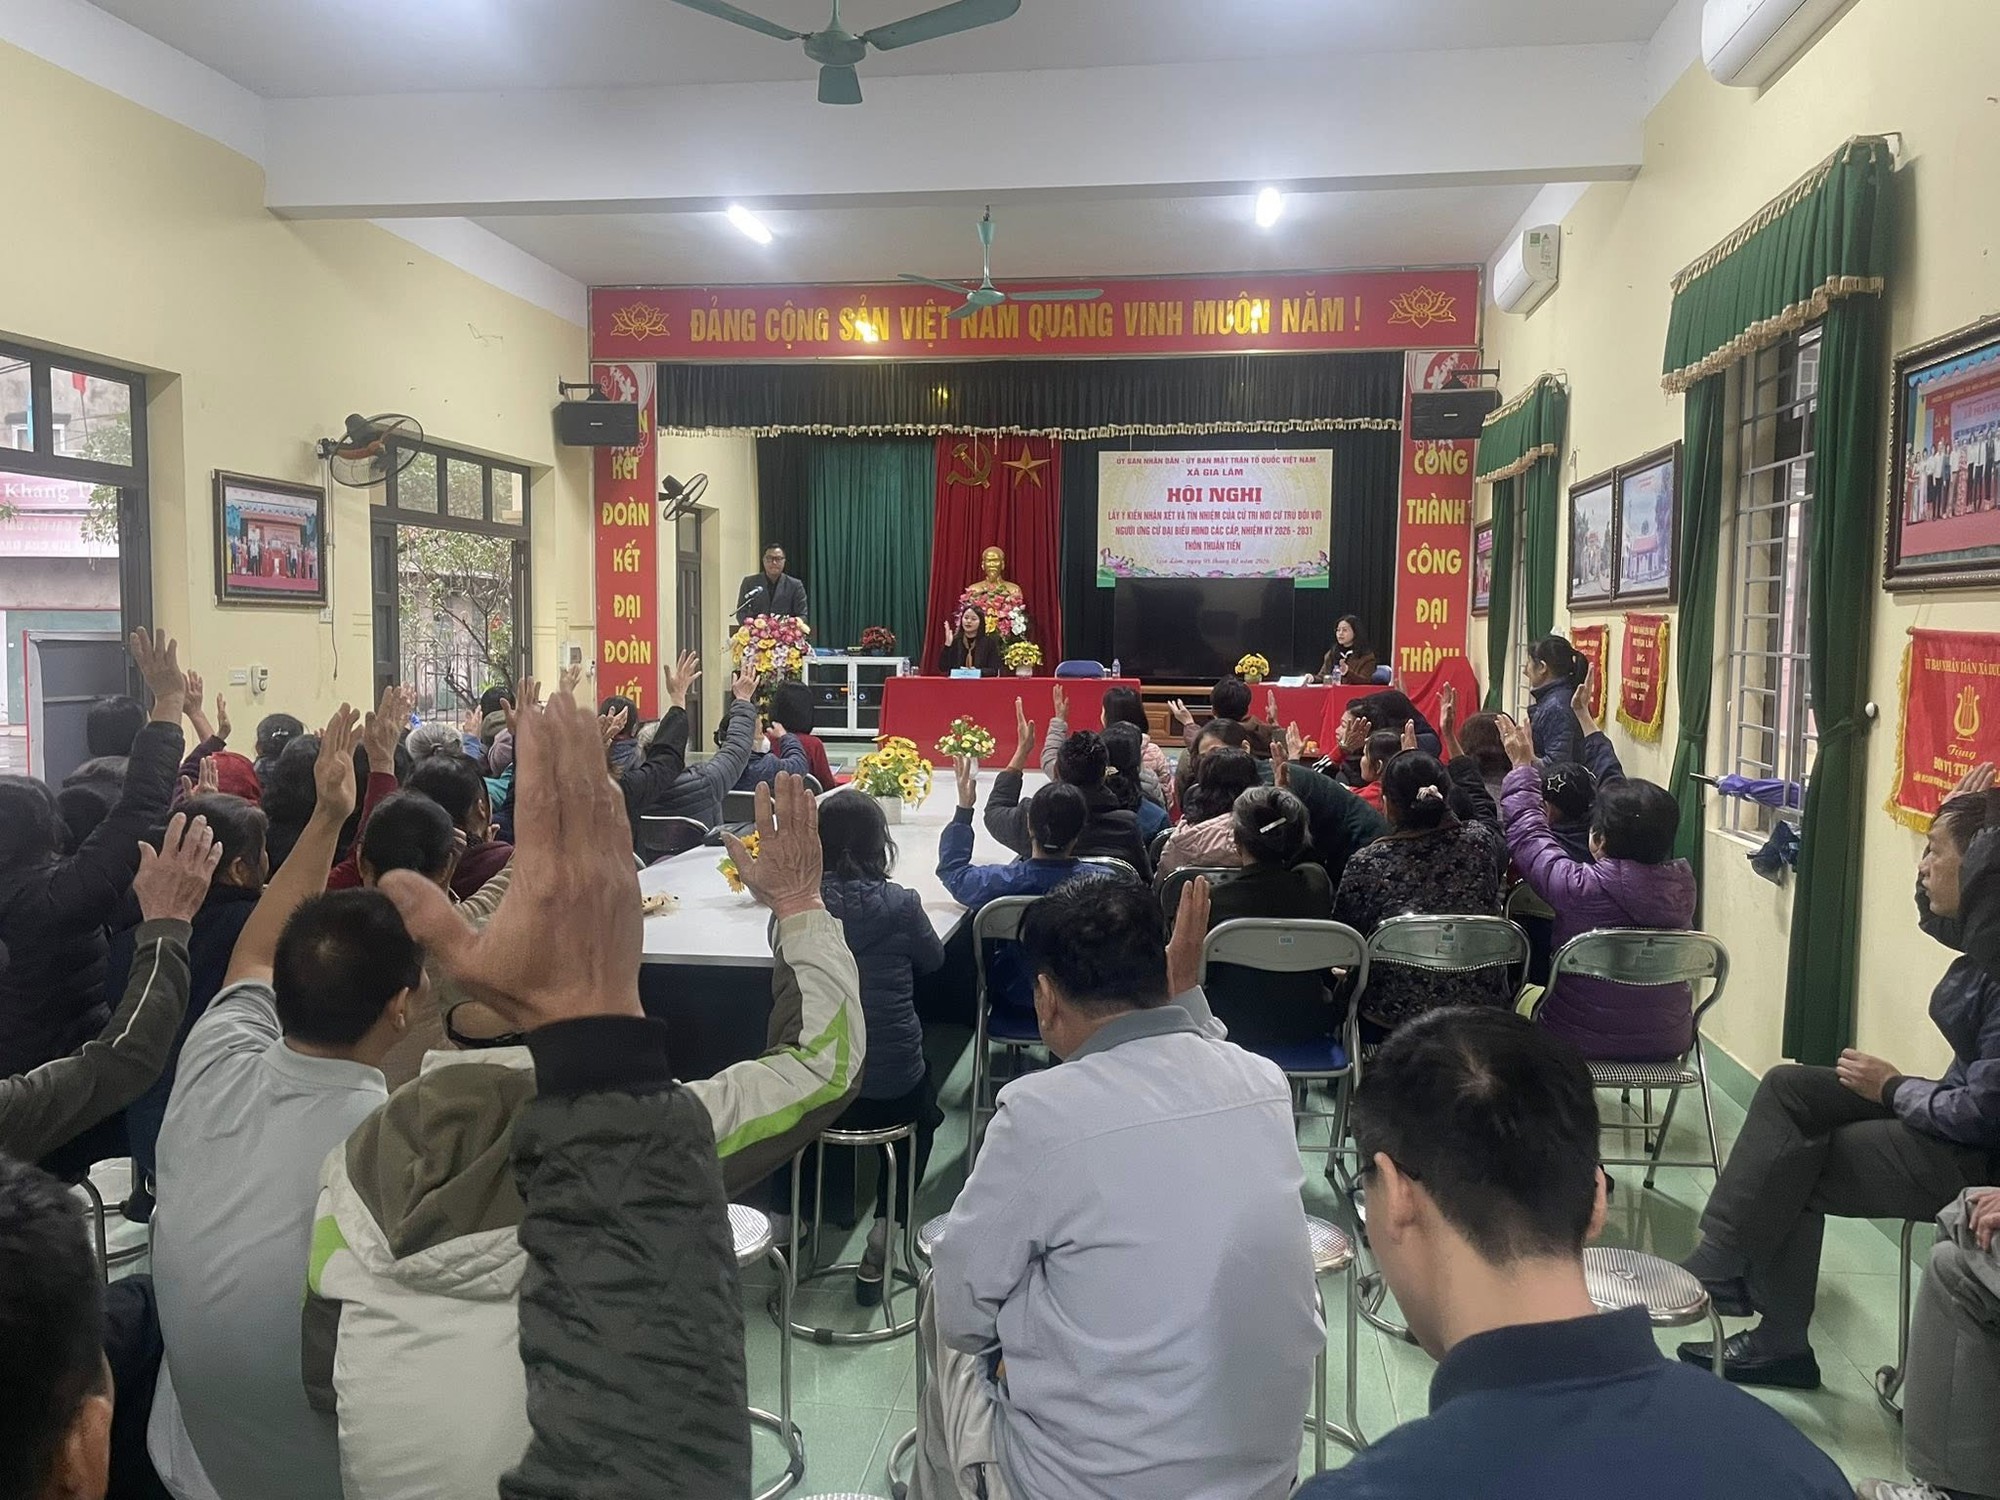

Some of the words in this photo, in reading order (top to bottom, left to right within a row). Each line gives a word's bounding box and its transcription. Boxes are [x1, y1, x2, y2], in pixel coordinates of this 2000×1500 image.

[690, 296, 756, 342] ĐẢNG
[765, 300, 829, 350] CỘNG
[839, 294, 889, 342] SẢN
[900, 299, 950, 348] VIỆT
[961, 304, 1019, 339] NAM
[1028, 302, 1113, 342] QUANG
[1124, 301, 1183, 336] VINH
[1193, 290, 1271, 335] MUÔN
[1281, 289, 1344, 333] NĂM
[1354, 296, 1361, 332] !
[1203, 467, 1219, 476] GIA
[1222, 467, 1243, 476] LÂM
[1299, 456, 1316, 465] NAM
[4, 483, 70, 503] Khang
[1167, 485, 1202, 505] HỘI
[1209, 487, 1262, 505] NGHỊ
[602, 497, 649, 526] ĐOÀN
[1406, 493, 1465, 524] THÀNH
[1275, 525, 1291, 535] 2026
[1297, 525, 1312, 535] 2031
[613, 539, 641, 572] KẾT
[1406, 542, 1462, 574] CÔNG
[613, 594, 641, 624] ĐẠI
[1416, 598, 1448, 630] ĐẠI
[604, 634, 651, 664] ĐOÀN
